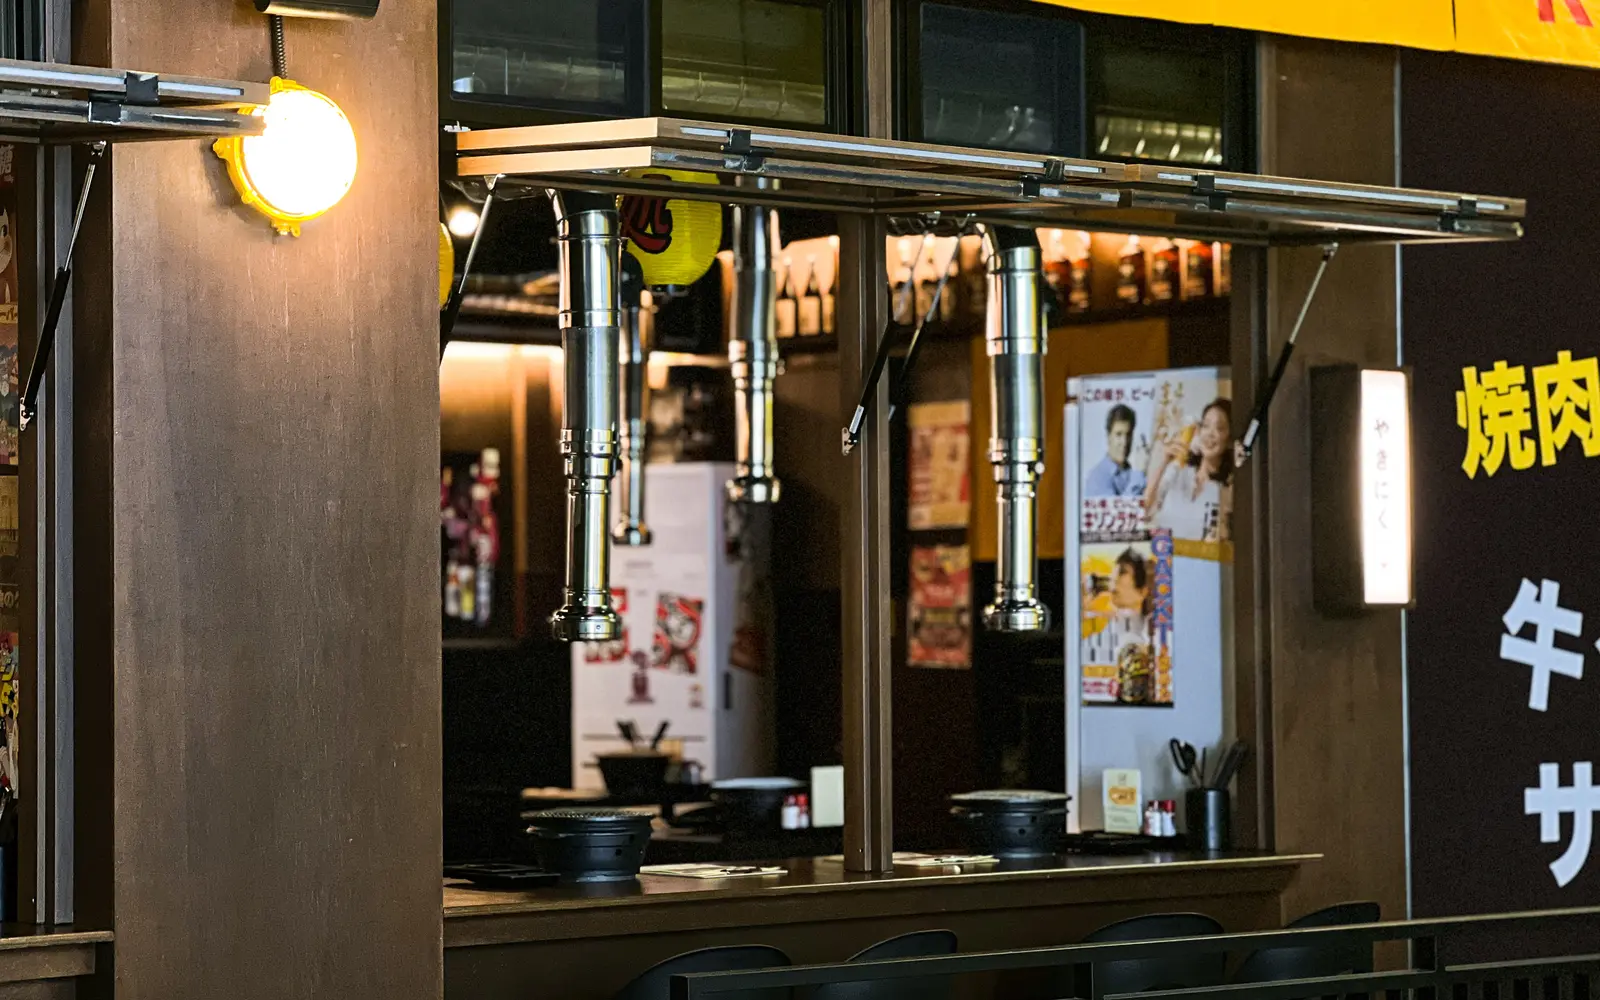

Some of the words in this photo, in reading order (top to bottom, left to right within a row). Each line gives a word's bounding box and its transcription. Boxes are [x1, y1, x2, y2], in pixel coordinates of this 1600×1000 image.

[1455, 350, 1600, 480] 焼肉
[1500, 577, 1600, 712] 牛
[1524, 761, 1600, 888] サ
